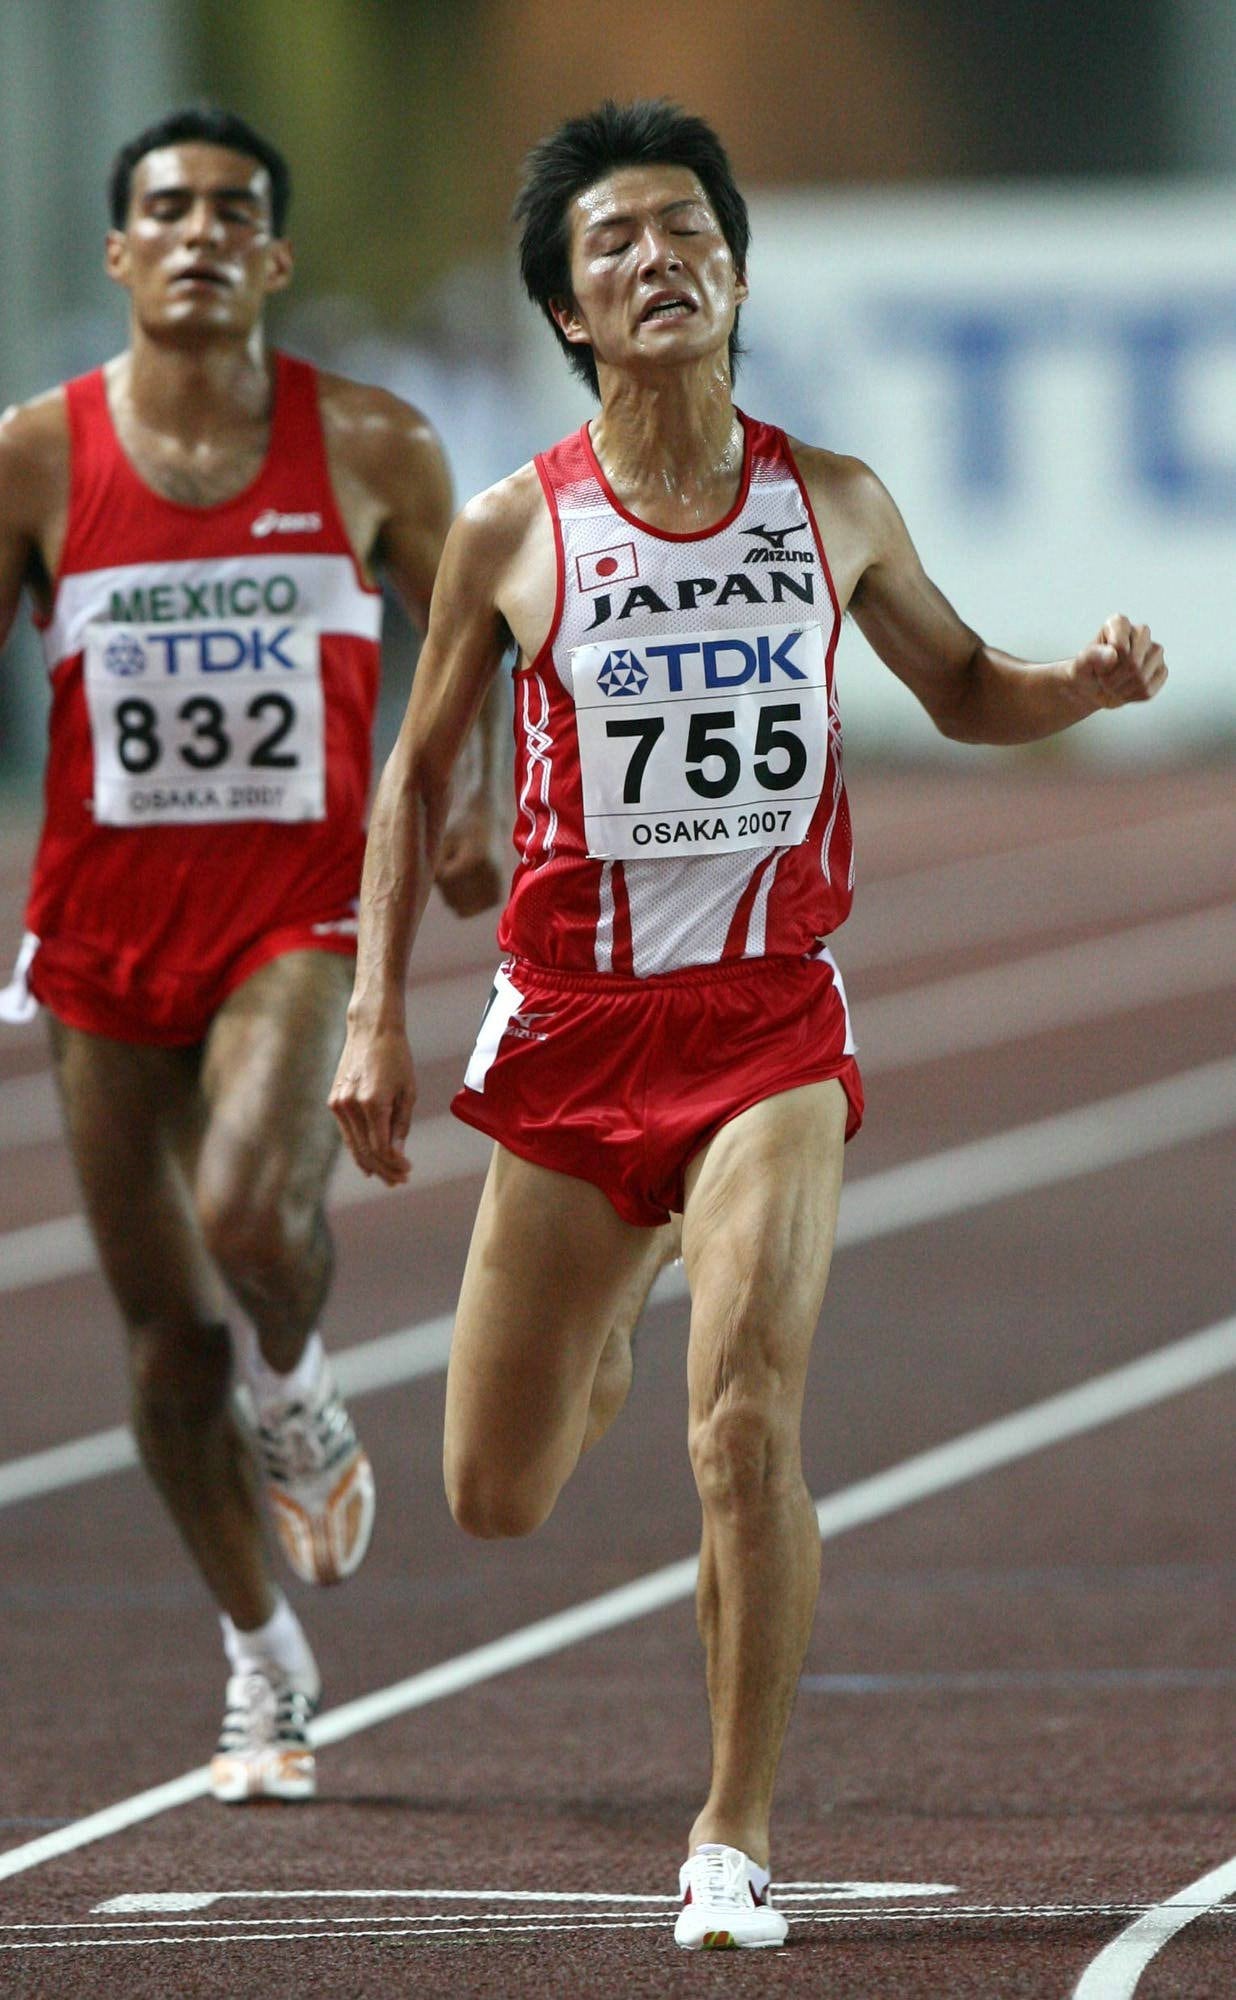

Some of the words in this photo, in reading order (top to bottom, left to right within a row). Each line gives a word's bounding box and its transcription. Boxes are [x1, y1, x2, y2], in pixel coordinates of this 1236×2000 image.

[110, 575, 299, 622] MEXICO
[583, 571, 814, 631] JAPAN
[147, 627, 298, 676] TDK
[645, 632, 808, 692] TDK
[115, 693, 299, 775] 832
[606, 703, 807, 804] 755
[130, 789, 221, 813] OSAKA
[632, 818, 730, 845] OSAKA
[738, 811, 792, 837] 2007
